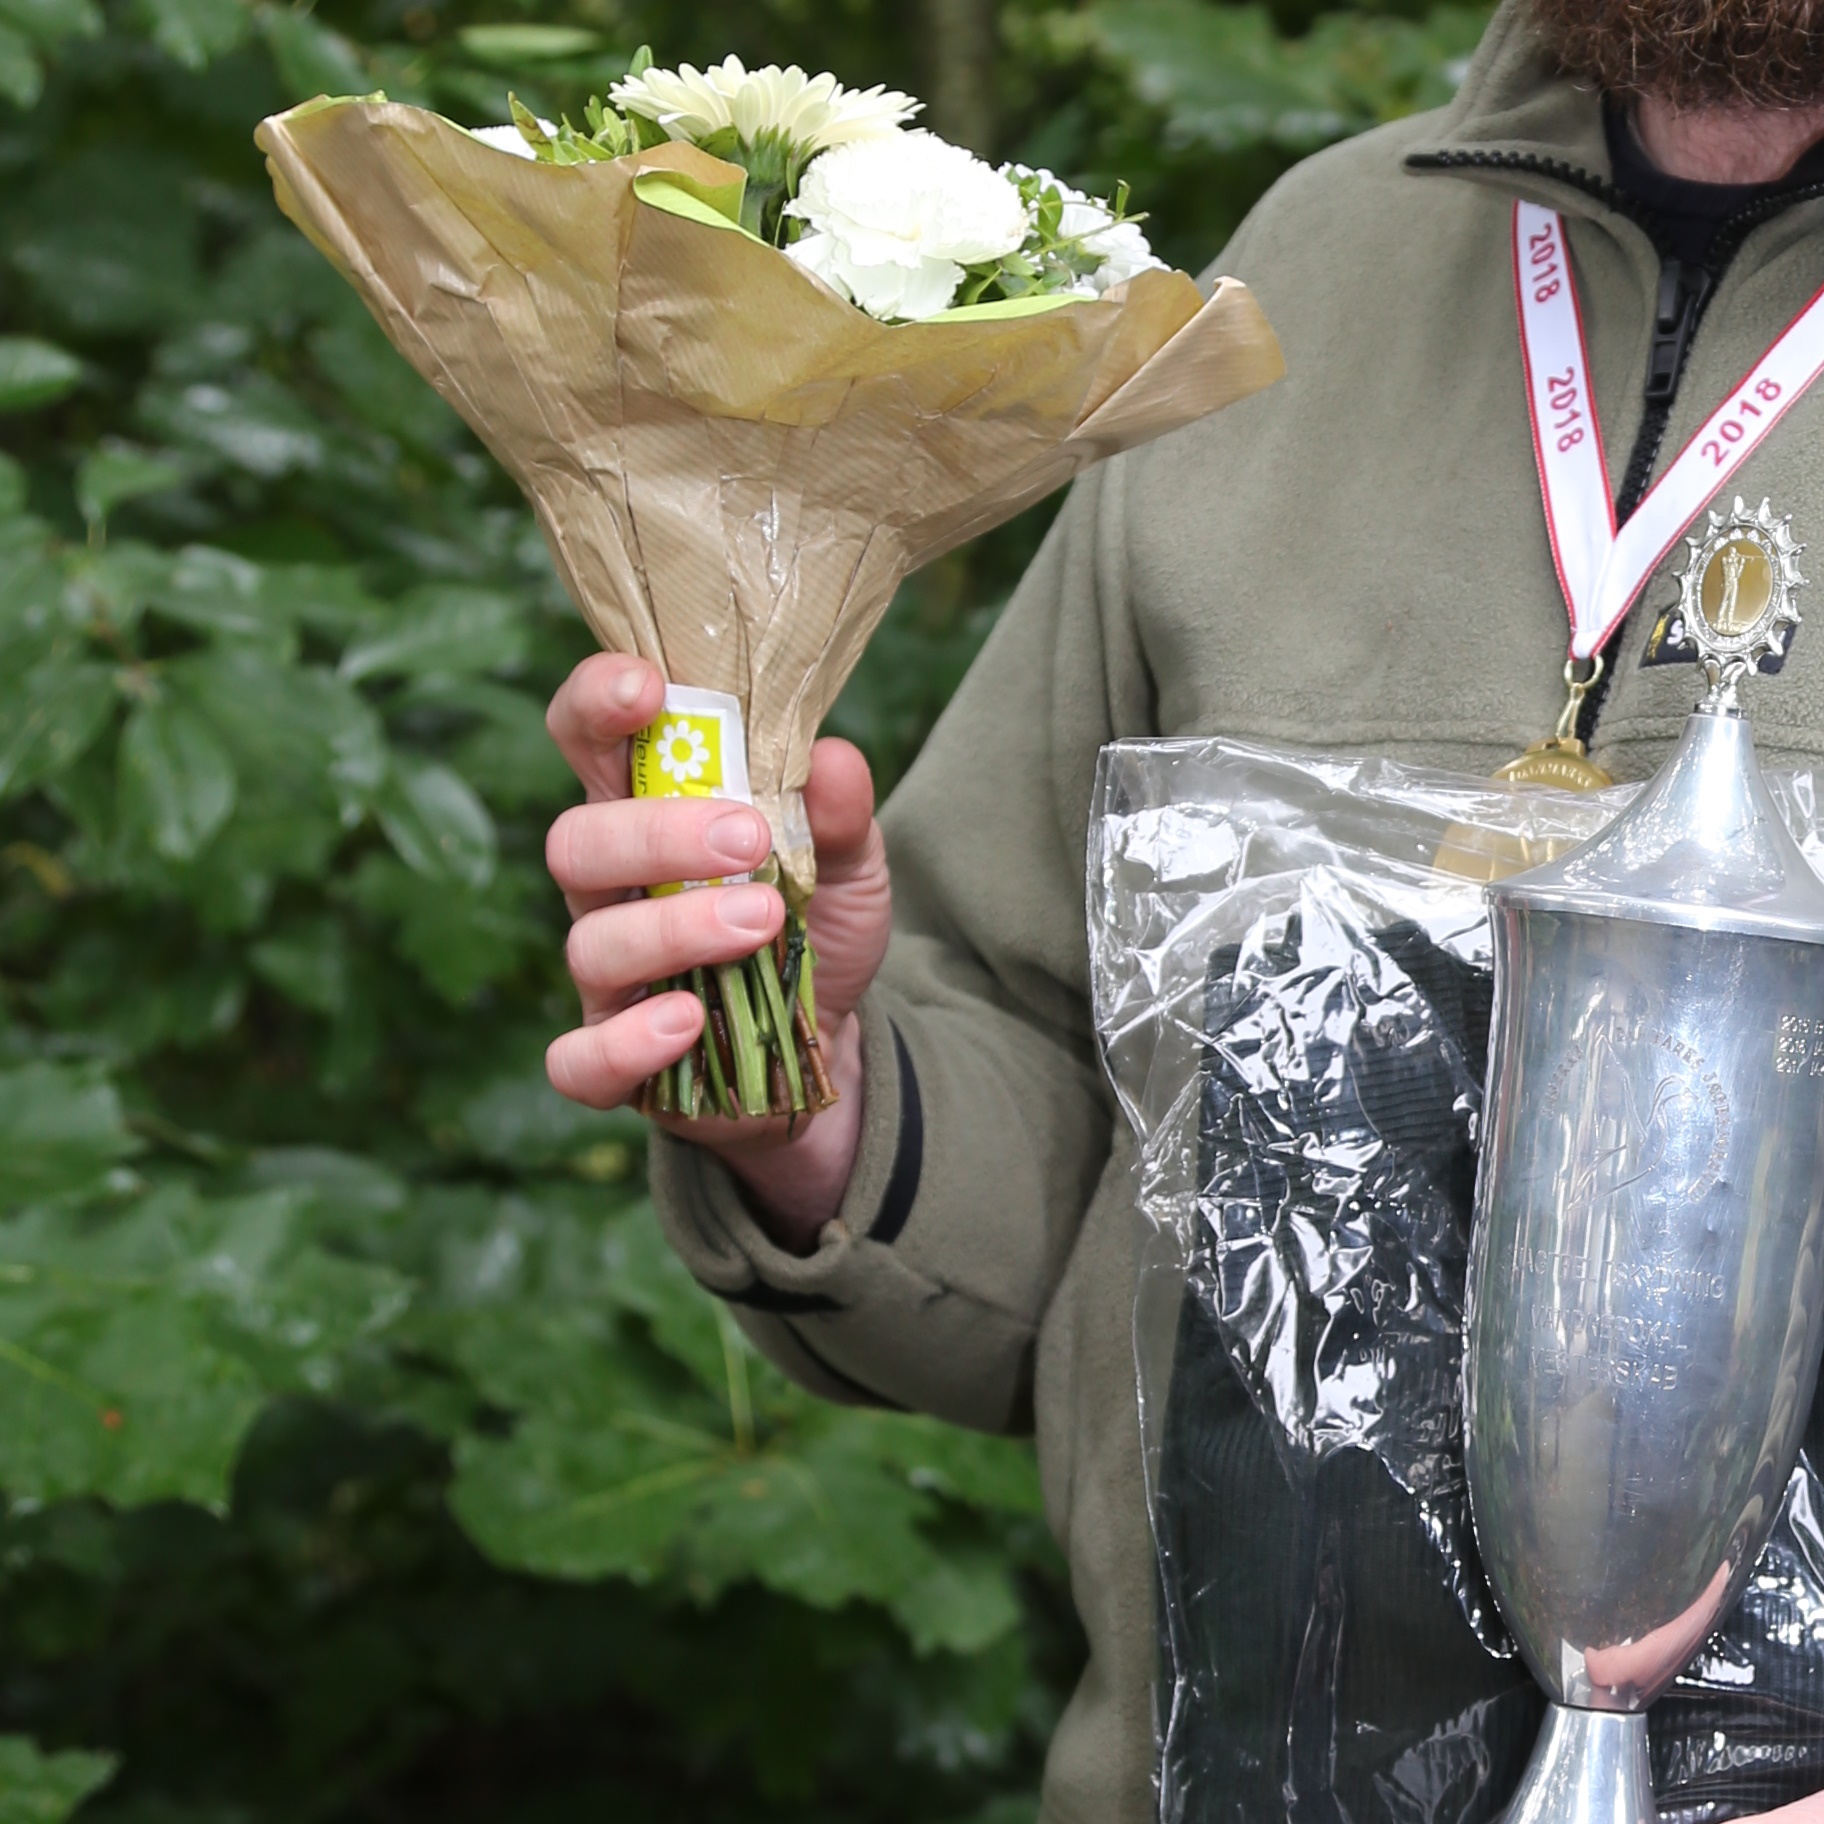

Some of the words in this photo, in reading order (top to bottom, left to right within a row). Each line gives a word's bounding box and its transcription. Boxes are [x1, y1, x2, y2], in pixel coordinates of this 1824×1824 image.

[1527, 222, 1562, 304] 2018
[1546, 366, 1585, 453] 2018
[1700, 376, 1783, 468] 2018
